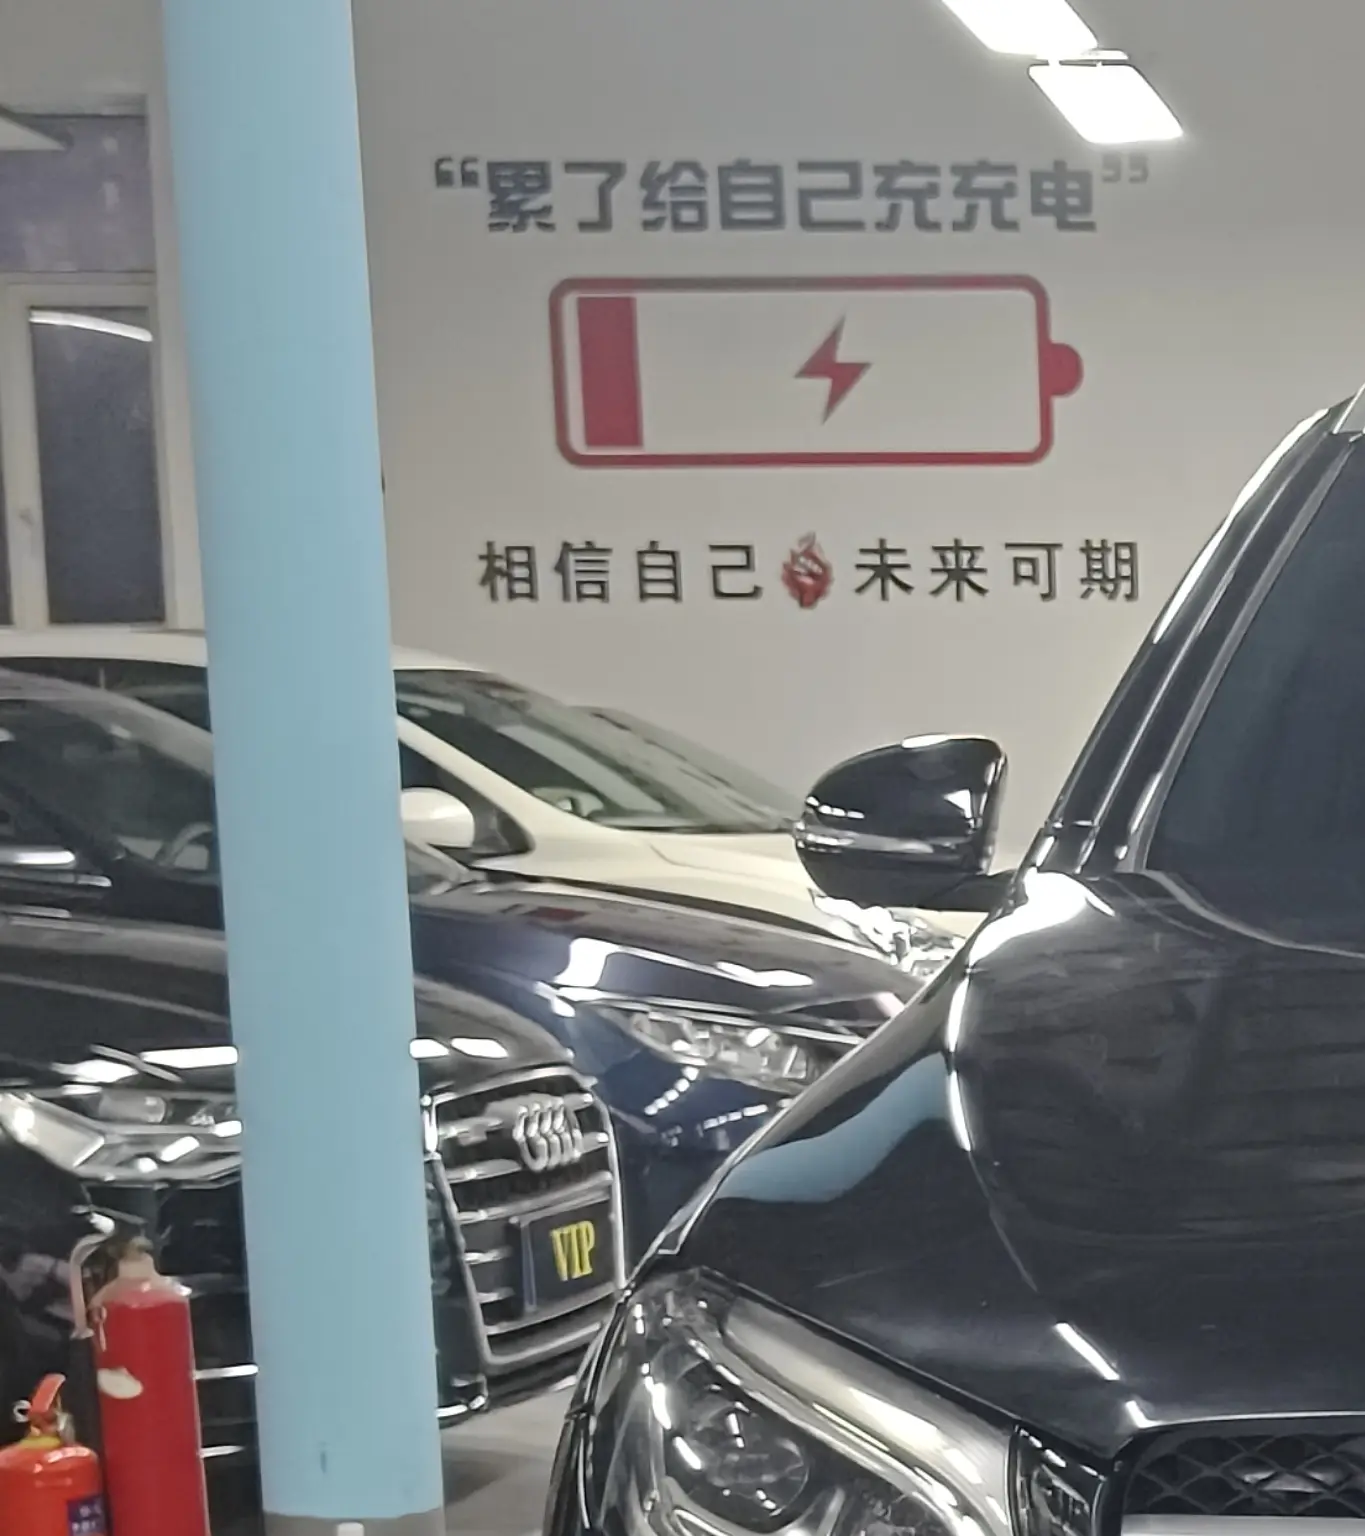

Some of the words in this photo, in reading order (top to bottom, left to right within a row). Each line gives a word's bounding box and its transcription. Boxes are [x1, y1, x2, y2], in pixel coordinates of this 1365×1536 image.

[476, 540, 765, 604] 相信自己
[853, 538, 1142, 603] 未来可期
[550, 1220, 596, 1282] VIP
